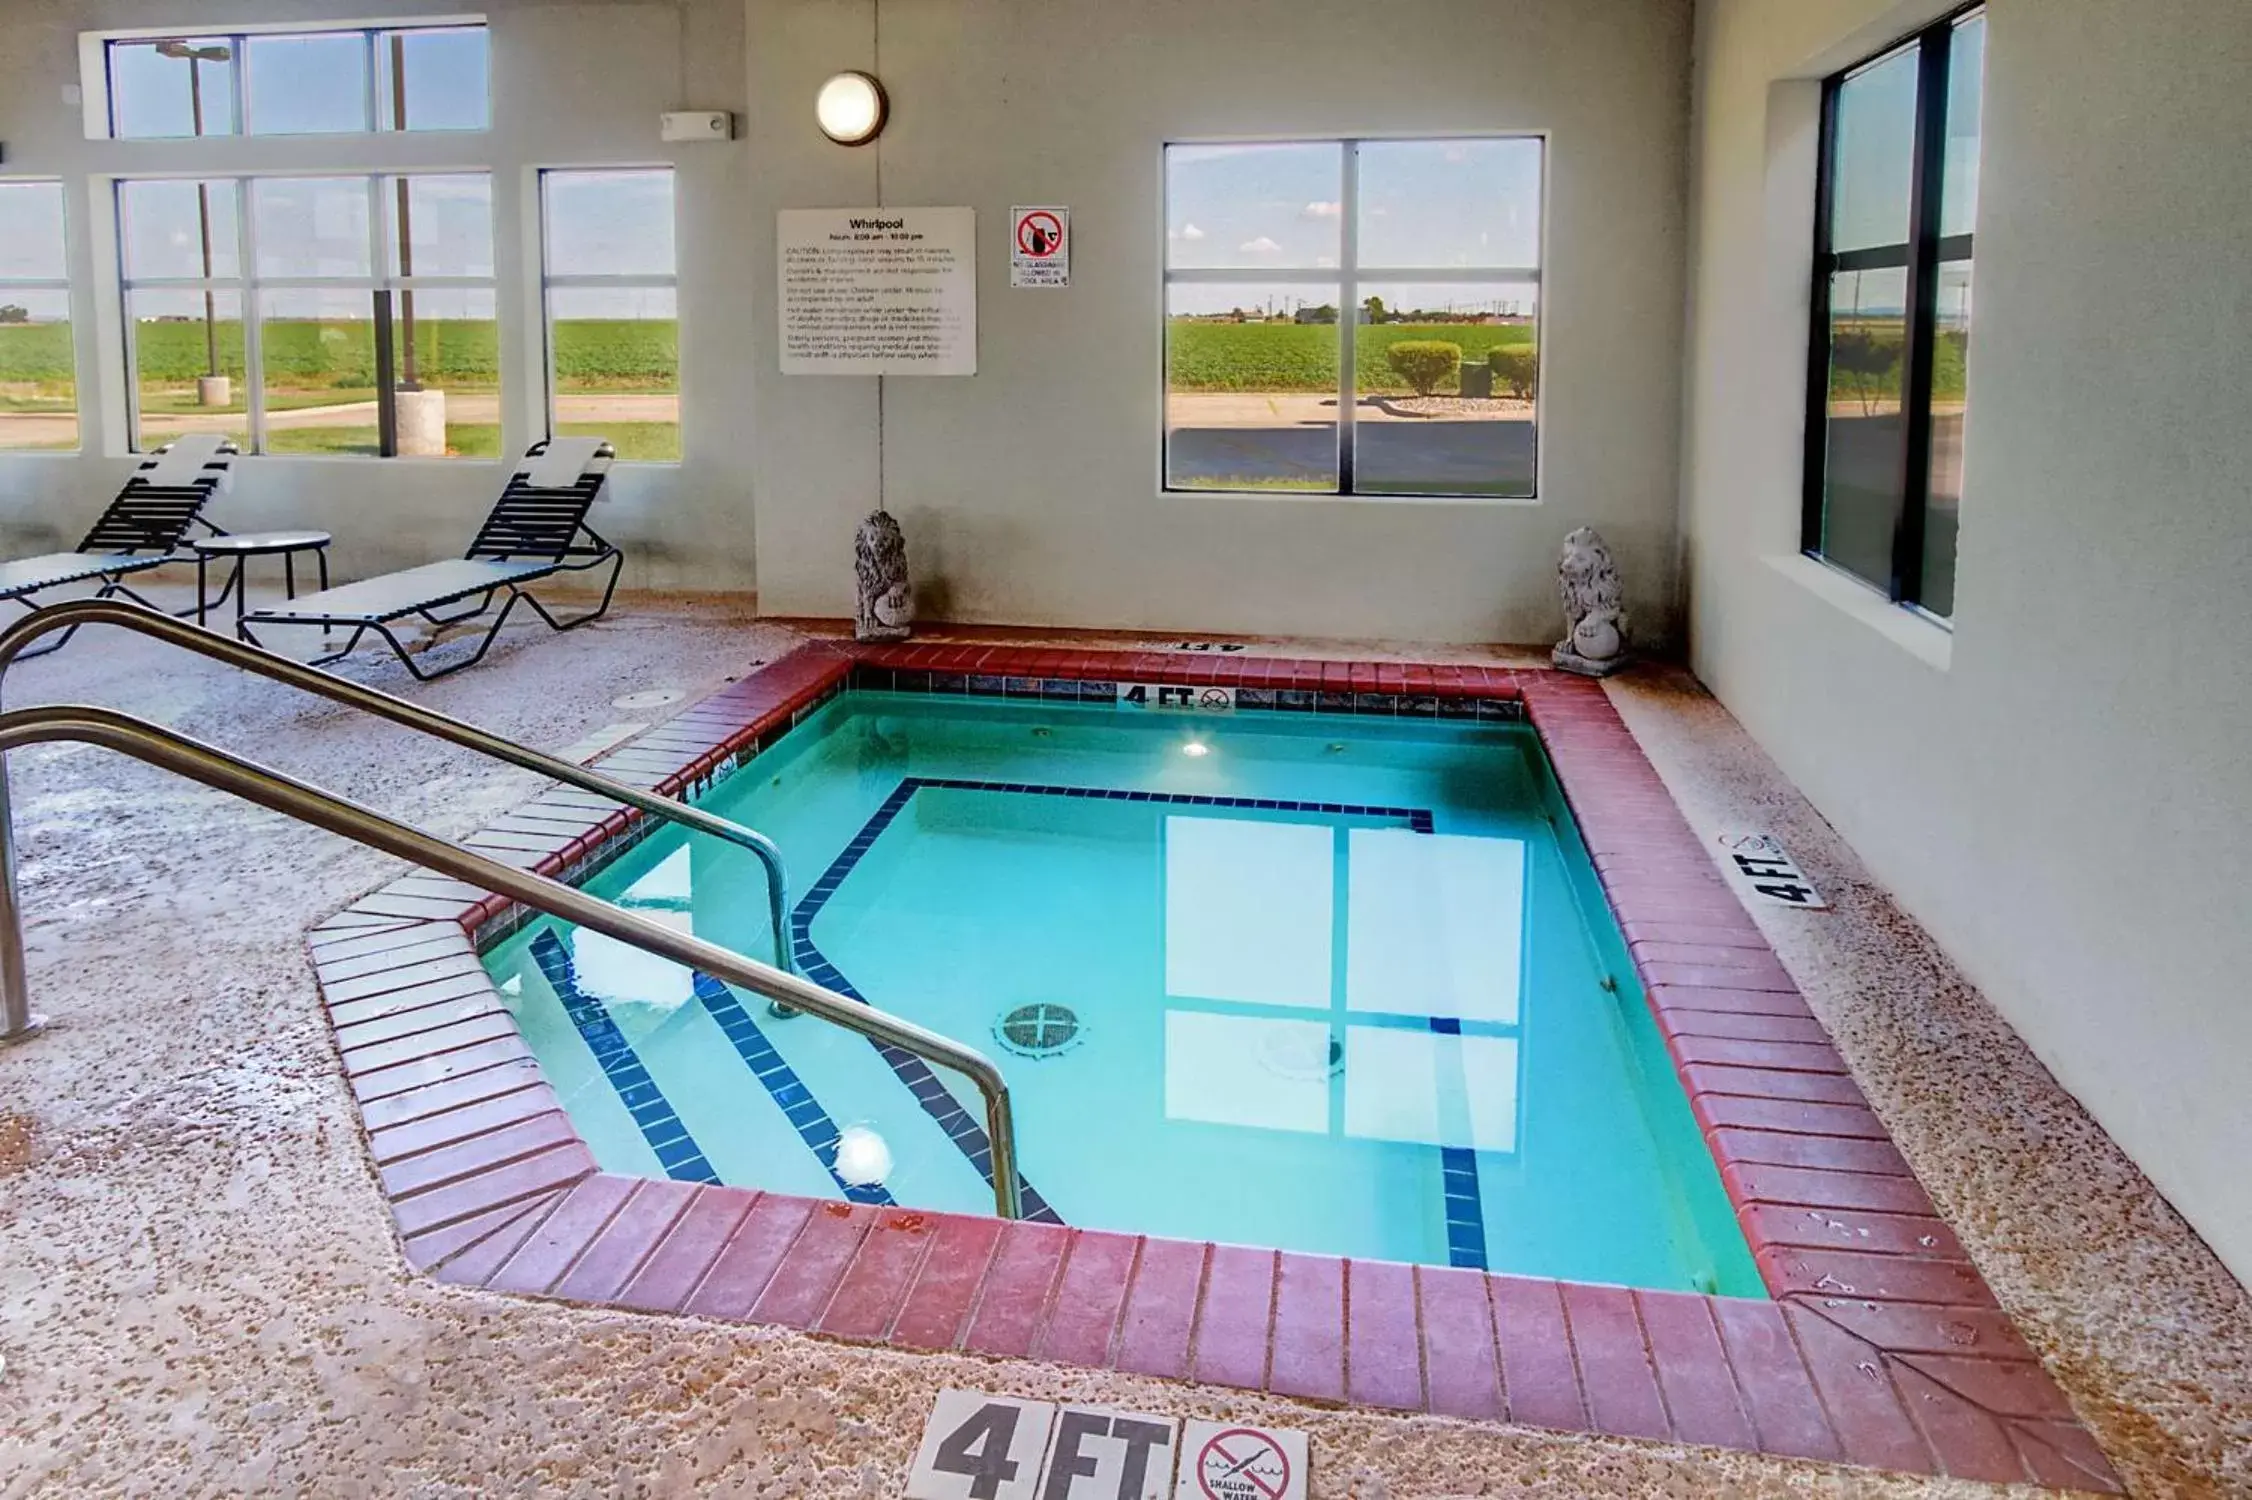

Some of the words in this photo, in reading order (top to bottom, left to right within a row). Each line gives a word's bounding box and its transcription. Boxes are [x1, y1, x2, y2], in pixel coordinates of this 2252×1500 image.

[849, 218, 903, 232] Whirlpool
[1158, 687, 1194, 707] FT
[1732, 854, 1799, 879] FT
[1754, 884, 1812, 903] 4
[932, 1403, 1021, 1500] 4
[1043, 1411, 1171, 1500] FT
[1209, 1480, 1255, 1492] SHALLOW
